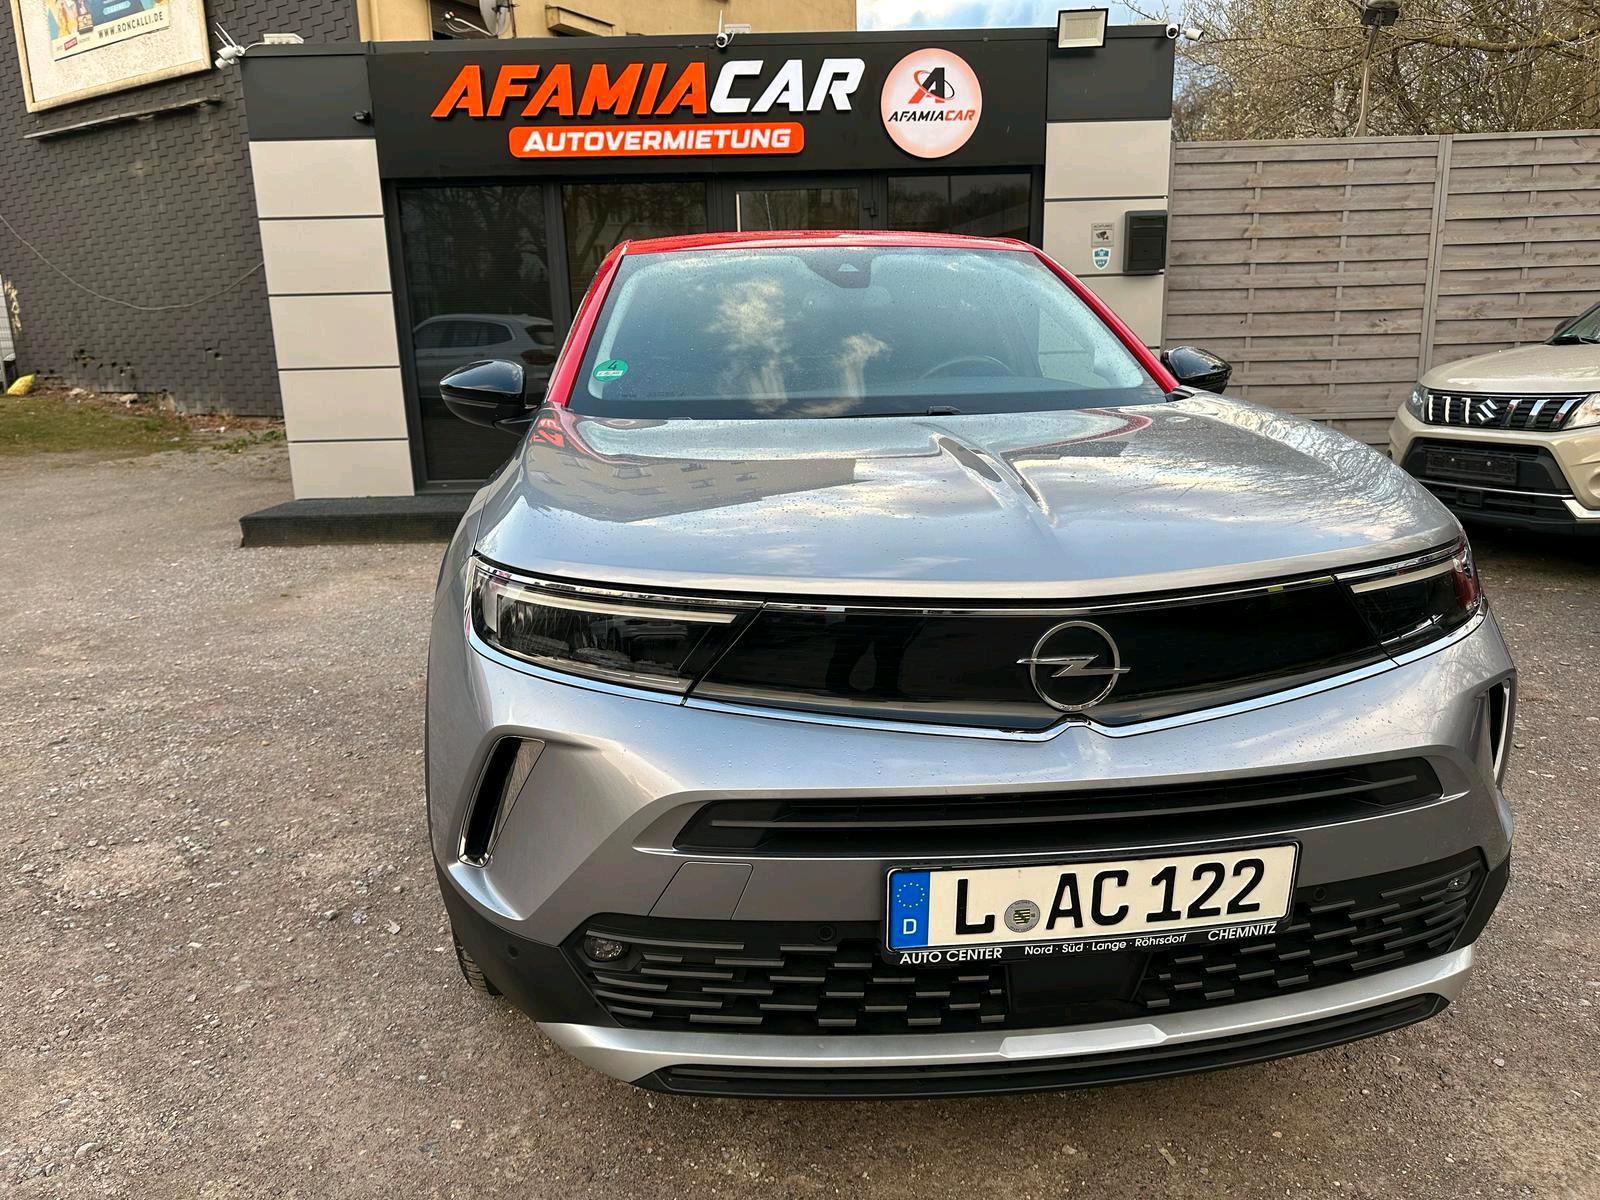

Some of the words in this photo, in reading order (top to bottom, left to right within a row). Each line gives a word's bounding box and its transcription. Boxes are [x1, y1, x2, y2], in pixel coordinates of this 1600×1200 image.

[98, 12, 163, 38] WWW.RONCALLI.DE
[431, 58, 866, 118] AFAMIACAR
[888, 109, 976, 122] AFAMIACAR
[523, 129, 791, 152] AUTOVERMIETUNG
[608, 360, 617, 370] 4
[955, 878, 996, 935] L
[1045, 870, 1129, 929] AC
[1146, 858, 1264, 922] 122
[902, 918, 918, 935] D
[1207, 922, 1277, 942] CHEMNITZ
[1024, 945, 1053, 956] Nord
[1061, 942, 1083, 954] Süd
[1091, 939, 1127, 952] Lange
[1134, 933, 1187, 948] Röhrsdorf
[900, 951, 942, 965] AUTO
[946, 947, 1003, 962] CENTER
